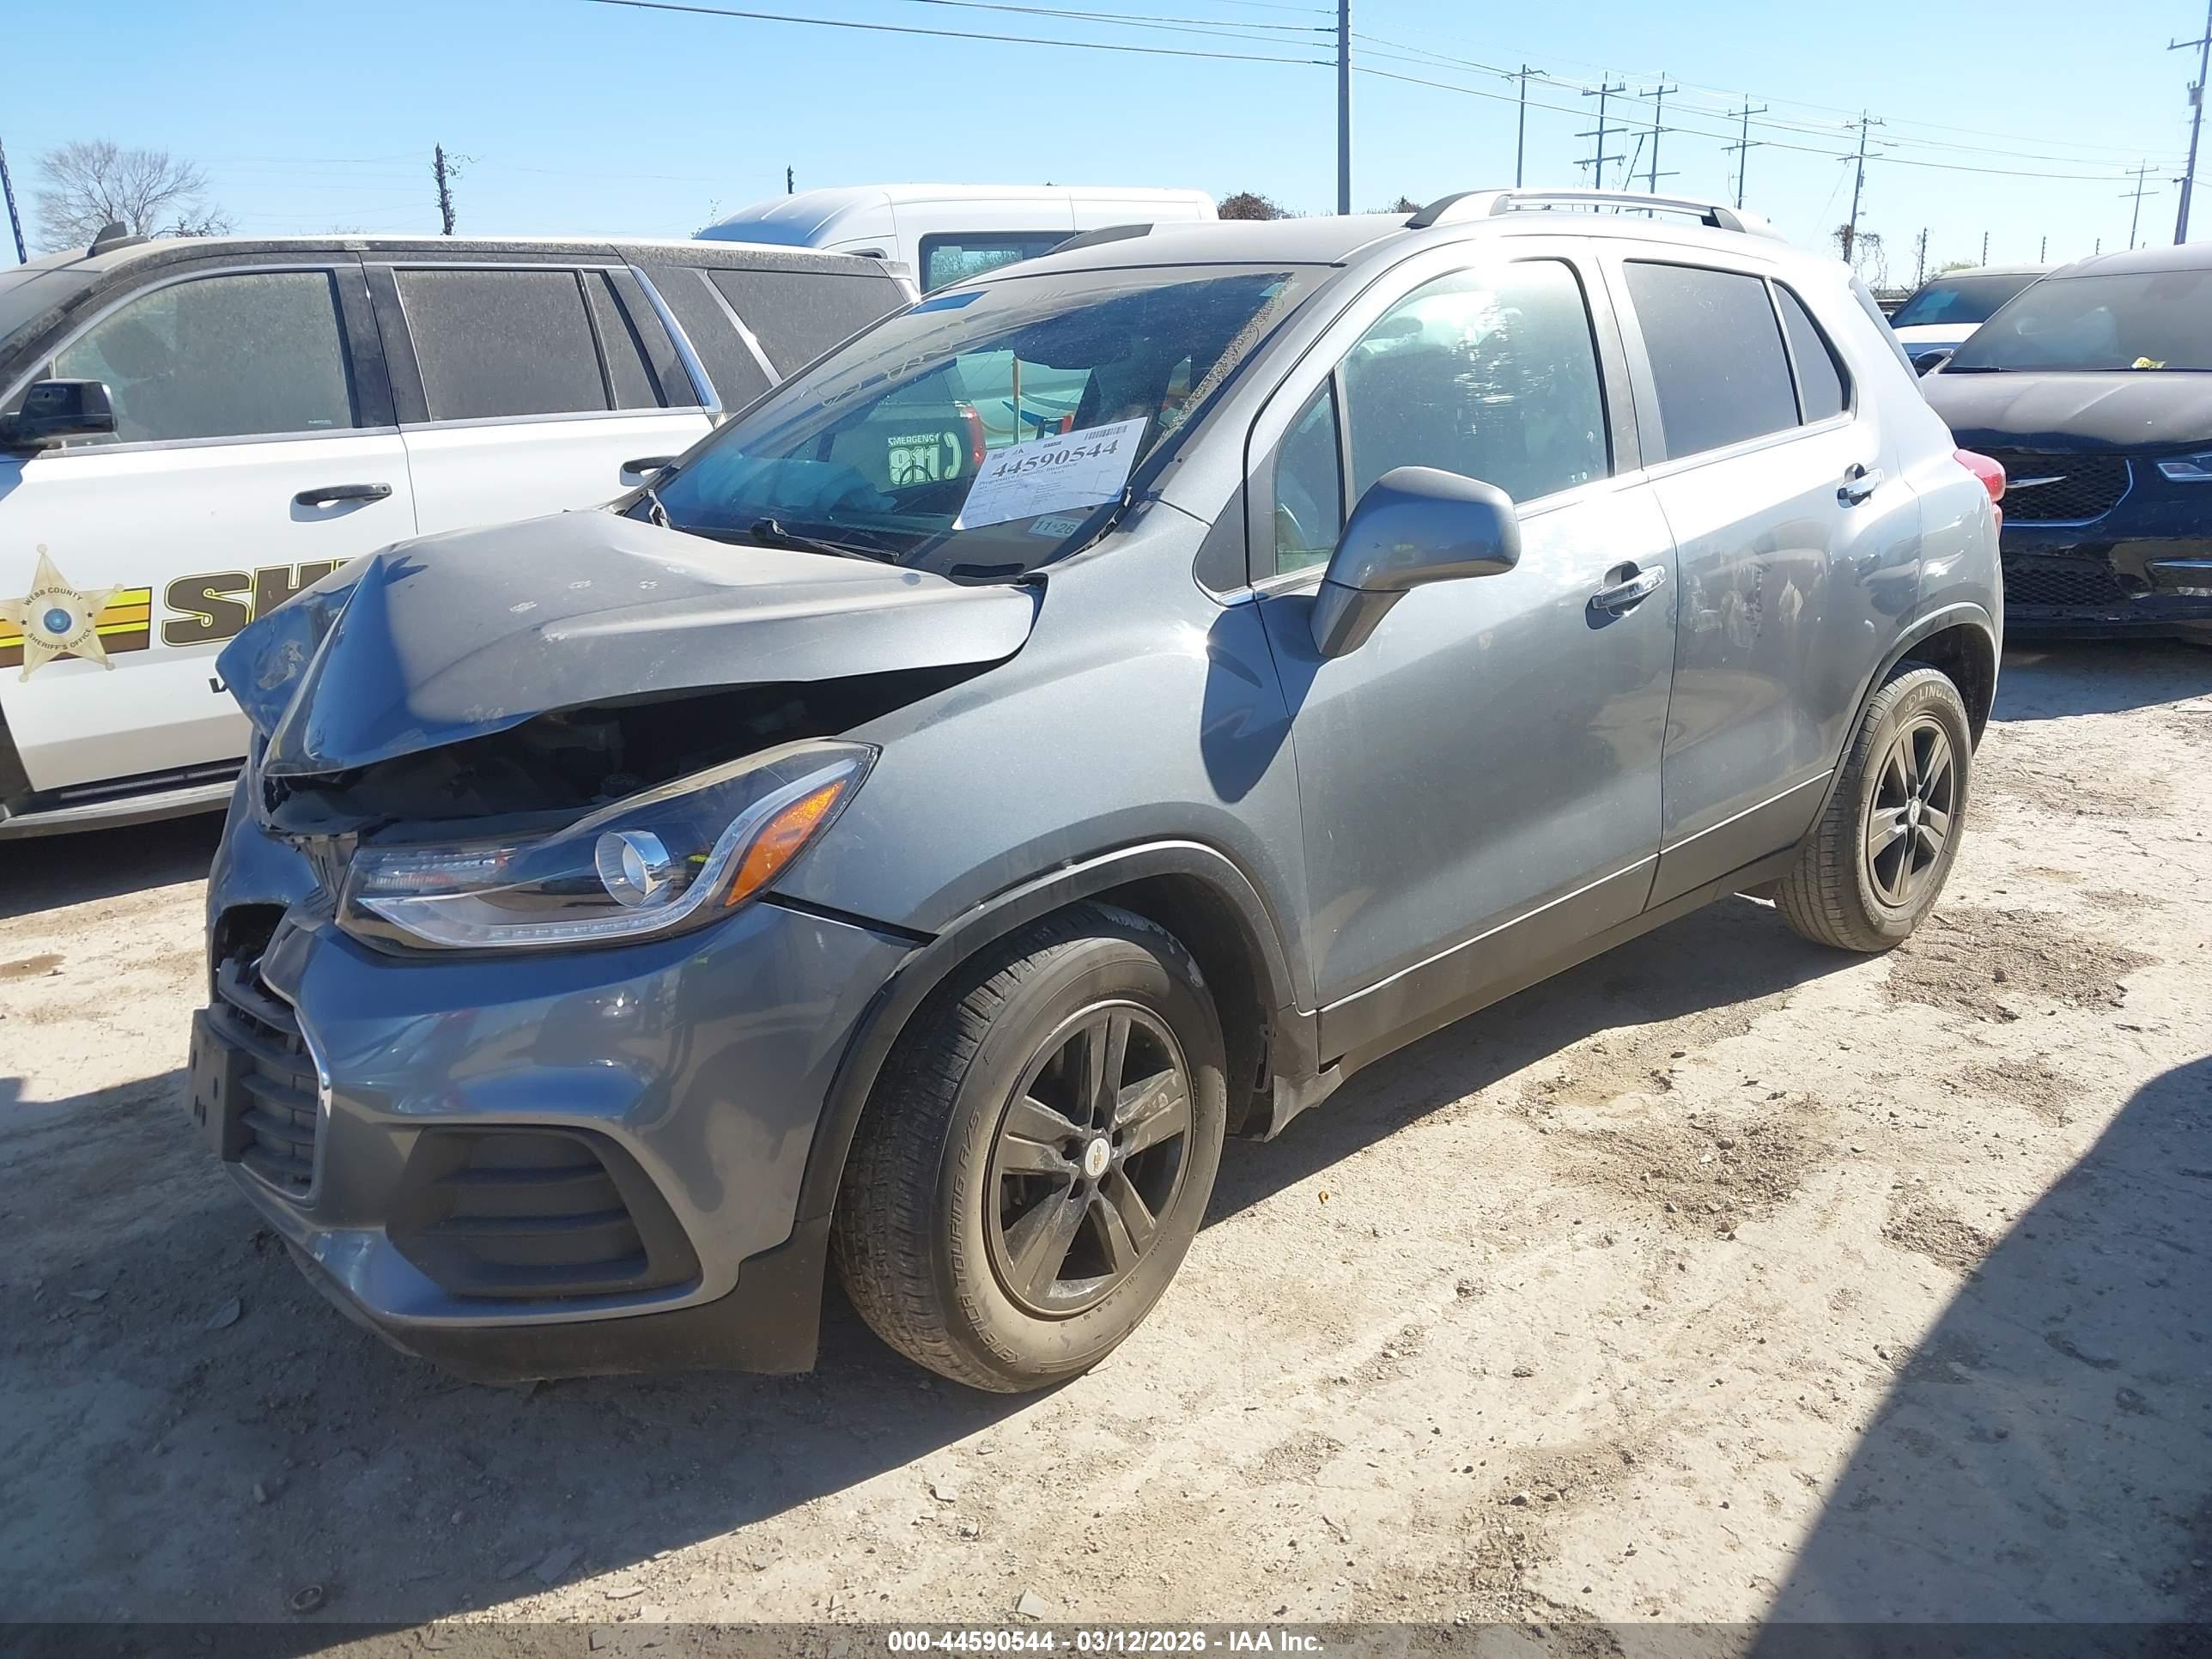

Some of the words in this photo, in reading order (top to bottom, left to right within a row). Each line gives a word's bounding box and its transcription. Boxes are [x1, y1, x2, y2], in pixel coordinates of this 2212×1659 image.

[888, 432, 941, 447] EMERGENCY
[889, 444, 939, 484] 911
[991, 439, 1119, 477] 44590544
[1036, 520, 1053, 531] 11
[1054, 523, 1076, 534] 26
[23, 589, 46, 606] WEBB
[47, 586, 83, 602] COUNTY
[161, 556, 356, 647] SH
[27, 633, 69, 650] SHERIFF'S
[70, 628, 92, 648] OFFICE
[951, 1173, 968, 1286] TOURING
